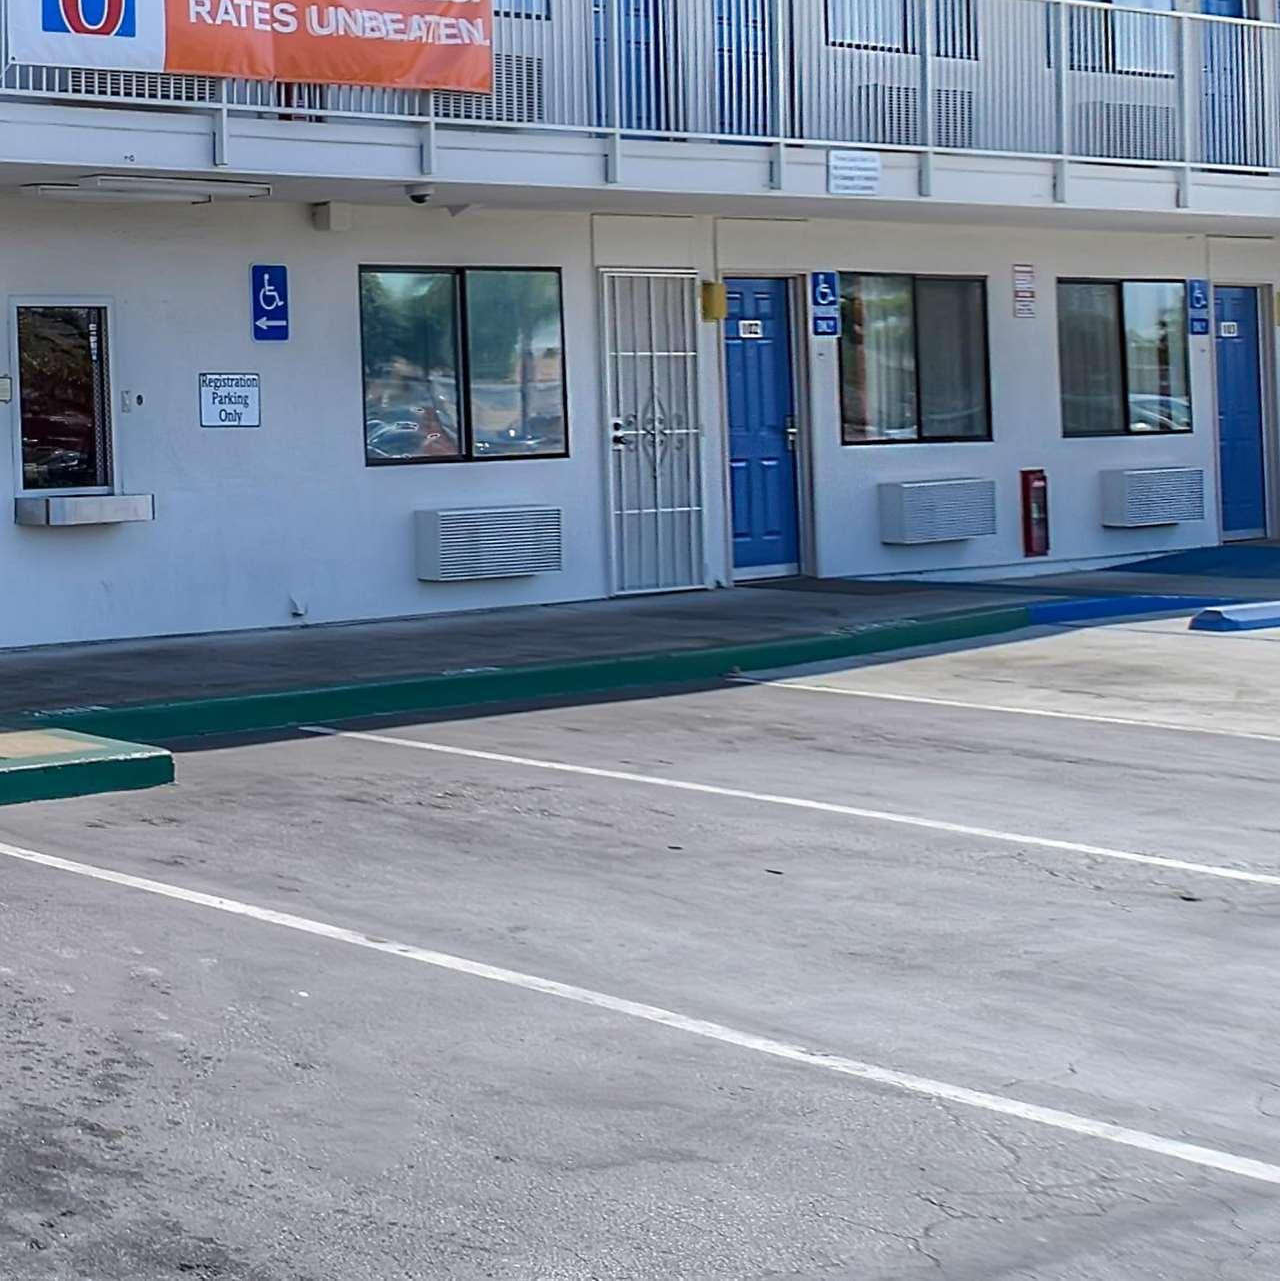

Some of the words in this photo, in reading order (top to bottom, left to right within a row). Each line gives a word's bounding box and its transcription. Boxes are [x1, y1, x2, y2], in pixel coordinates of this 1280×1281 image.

[306, 5, 490, 46] UNBEATEN.
[201, 374, 258, 390] Registration
[212, 391, 249, 408] Parking
[219, 408, 243, 424] Only
